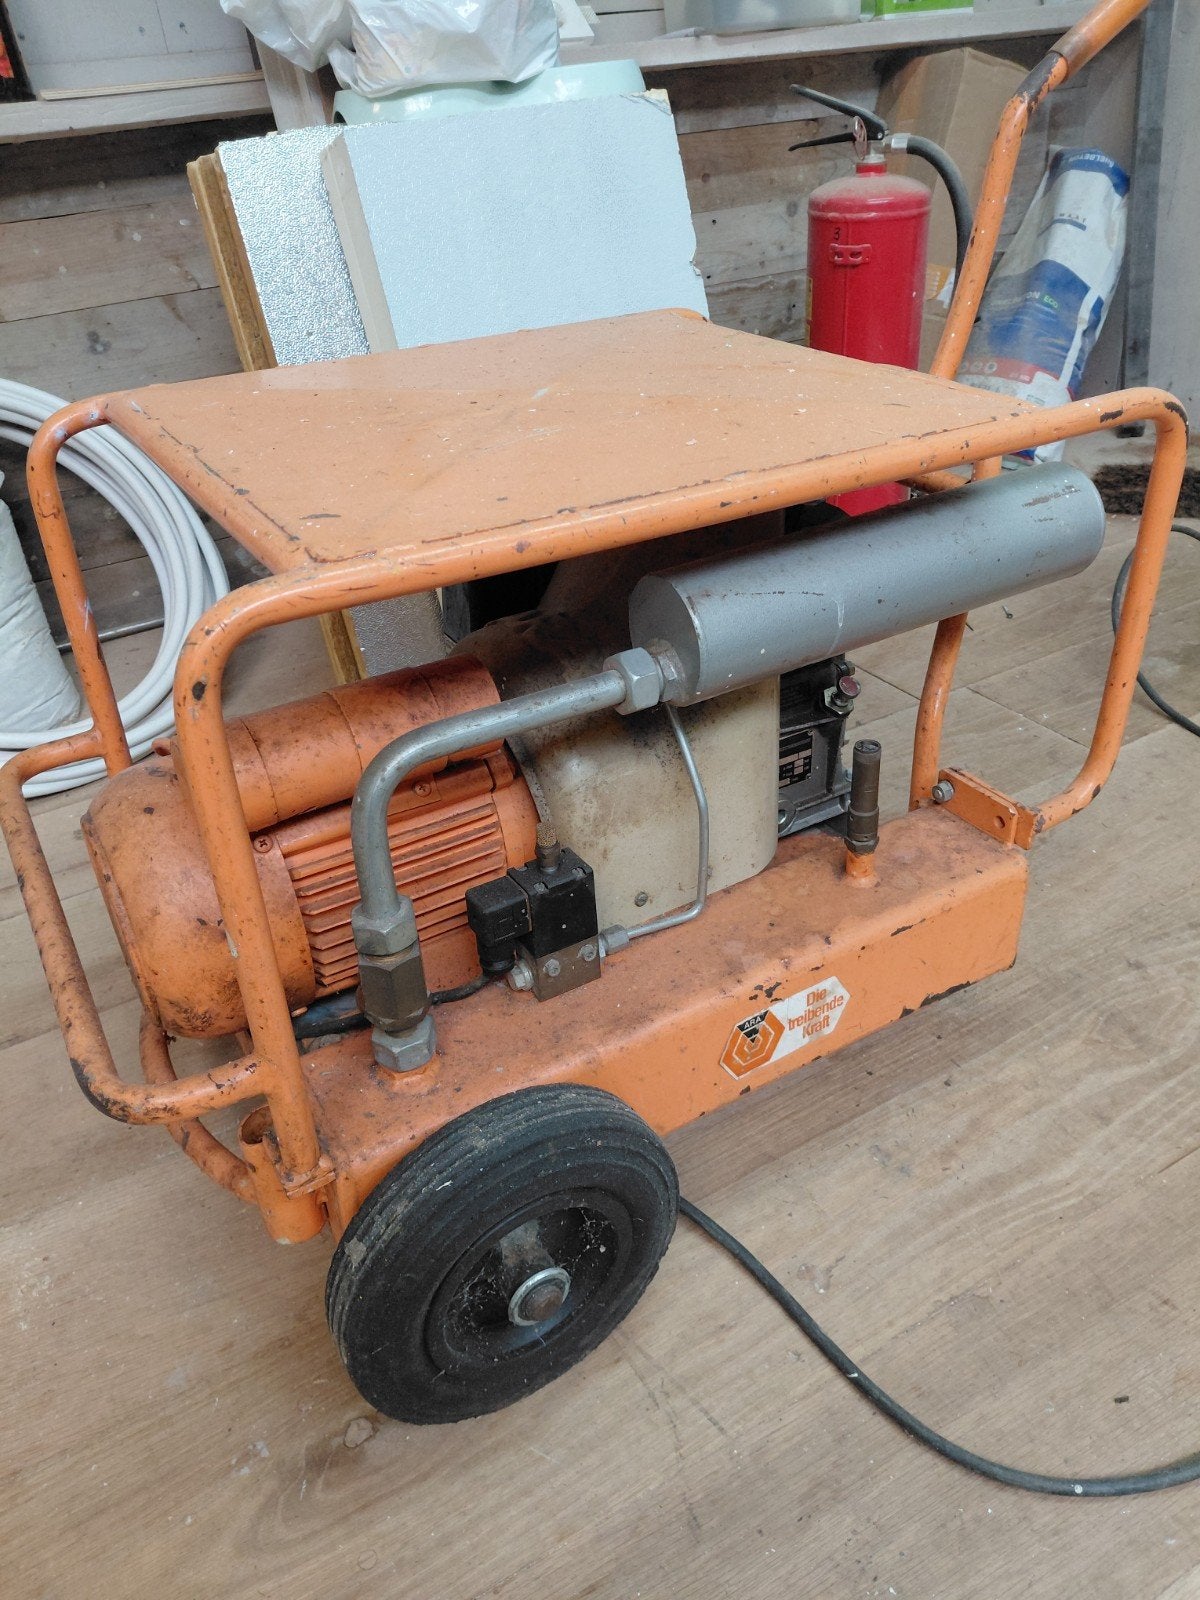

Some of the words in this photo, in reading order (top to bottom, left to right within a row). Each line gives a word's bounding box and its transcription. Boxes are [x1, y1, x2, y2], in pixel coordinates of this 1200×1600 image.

[833, 227, 841, 240] 3
[1043, 294, 1059, 309] ECO
[806, 989, 827, 1007] Die
[788, 995, 844, 1031] treibende
[744, 1016, 762, 1030] ARA
[802, 1015, 830, 1039] Kraft
